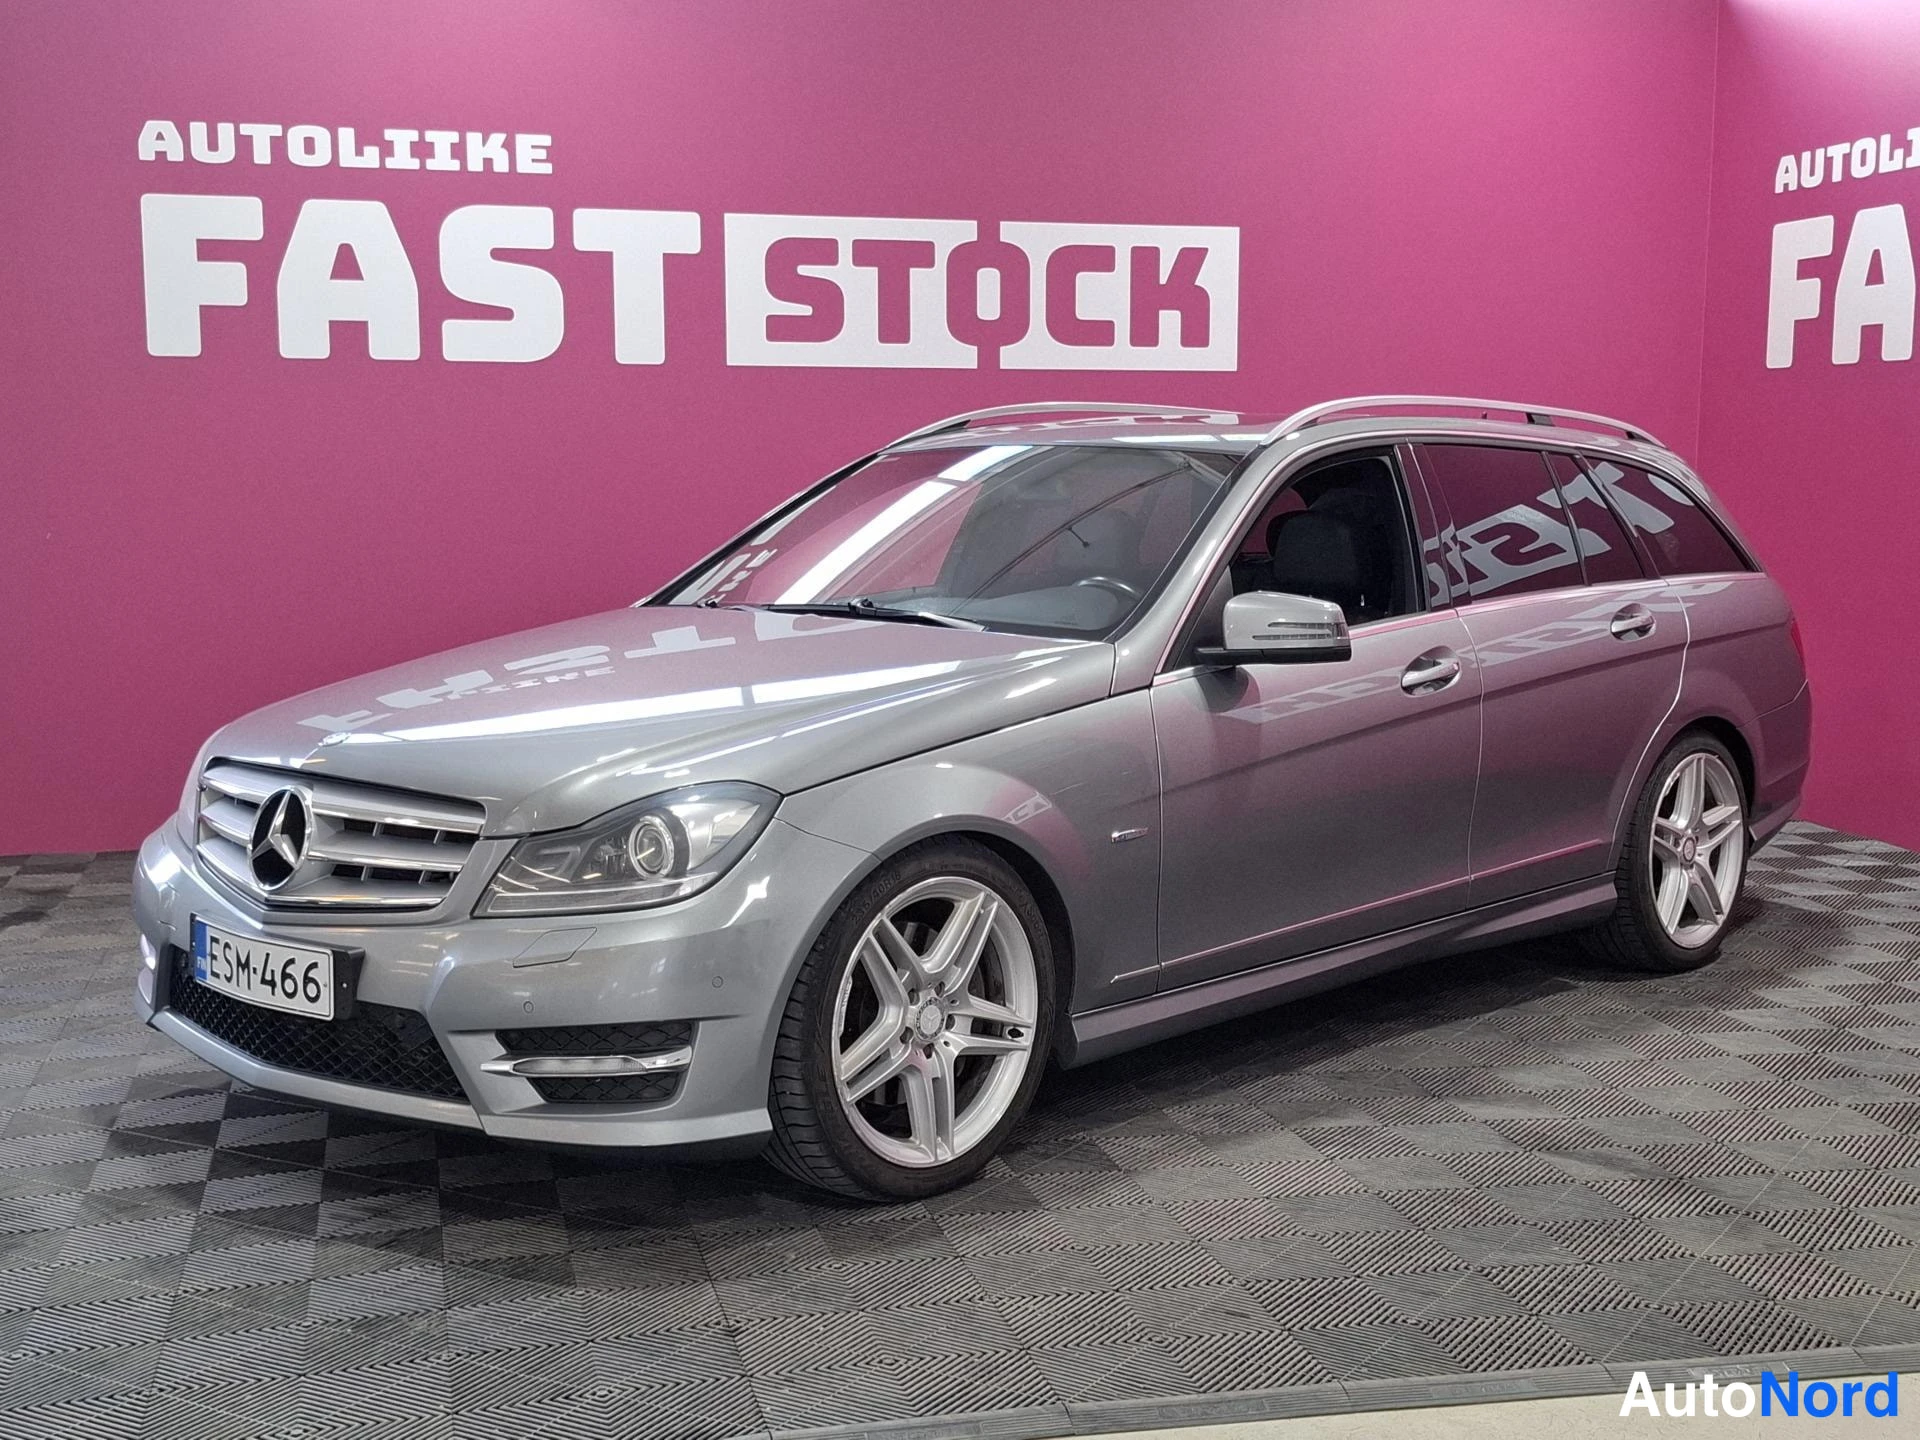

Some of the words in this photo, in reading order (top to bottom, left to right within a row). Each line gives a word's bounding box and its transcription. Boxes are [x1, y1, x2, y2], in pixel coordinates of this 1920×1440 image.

[137, 119, 553, 175] AUTOLIIKE
[140, 192, 702, 365] FAST
[764, 236, 1211, 348] STOCK
[209, 935, 322, 1004] ESM-466
